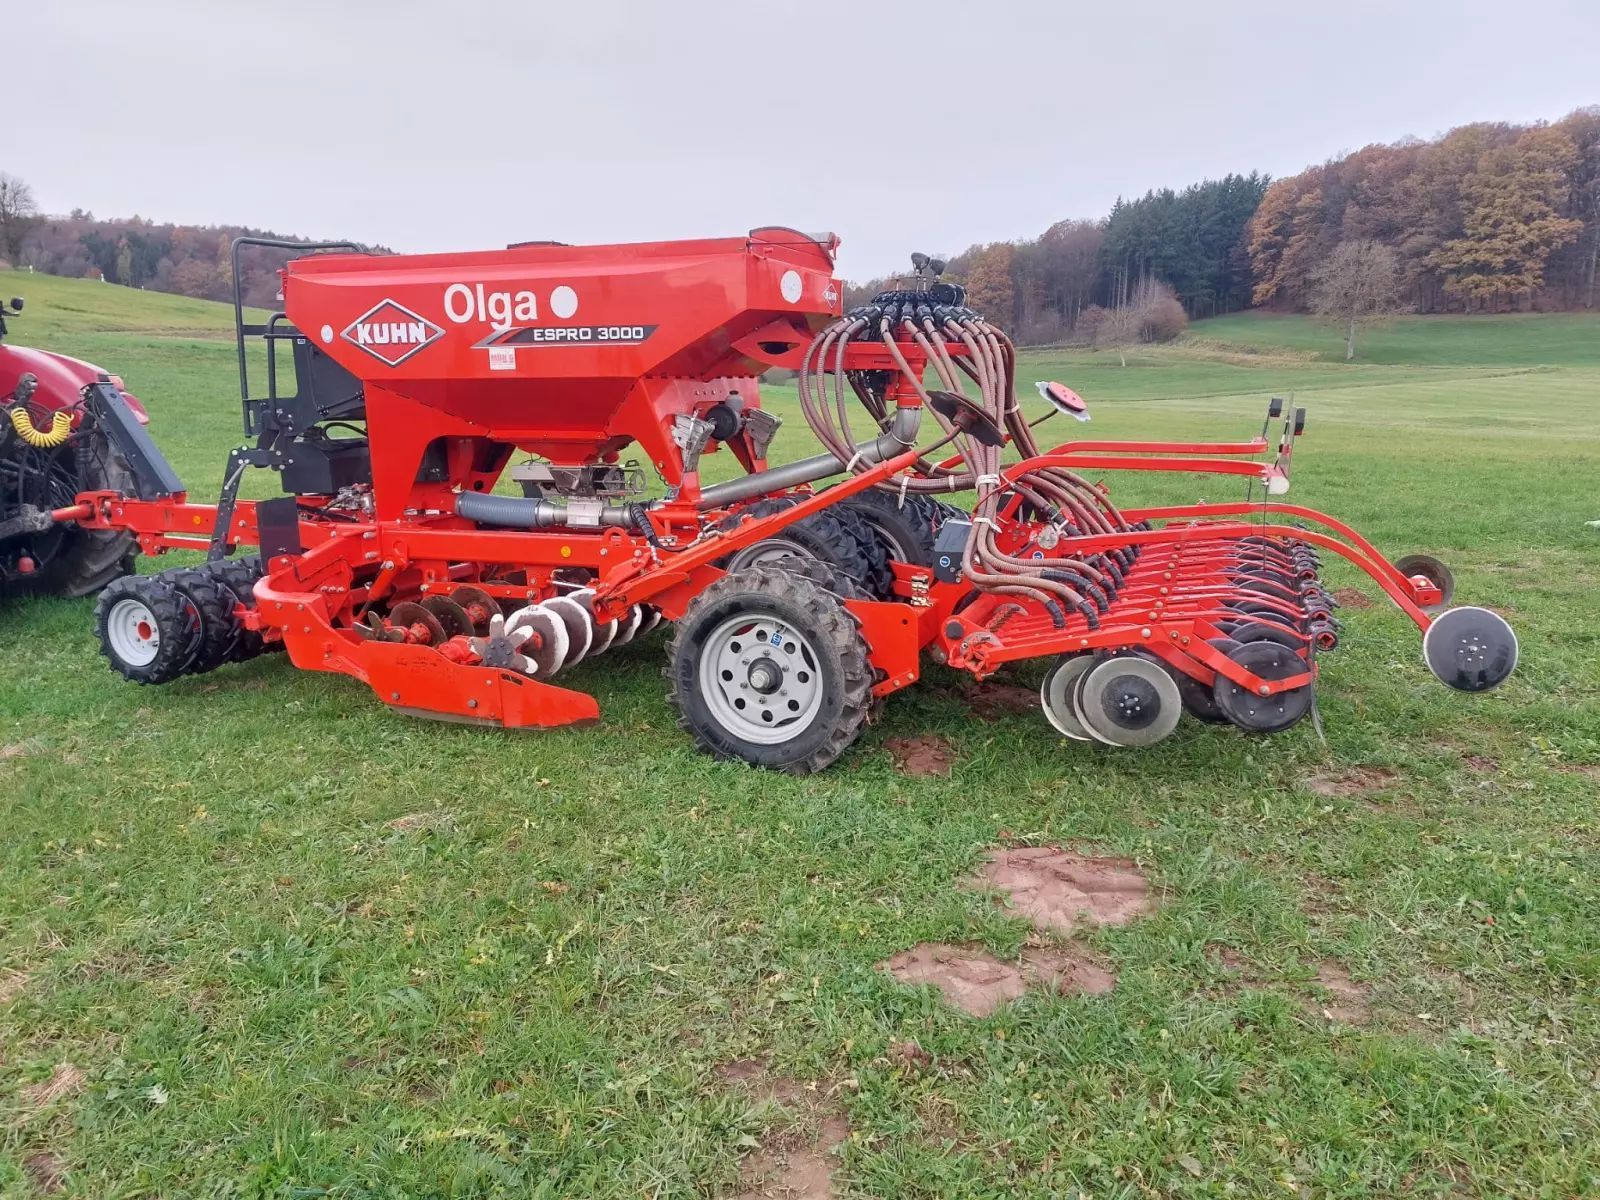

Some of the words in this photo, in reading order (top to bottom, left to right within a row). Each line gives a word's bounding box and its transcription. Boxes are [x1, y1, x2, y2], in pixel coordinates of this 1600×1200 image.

[444, 283, 537, 331] Olga
[356, 322, 427, 345] KUHN
[533, 328, 592, 342] ESPRO
[597, 326, 645, 341] 3000
